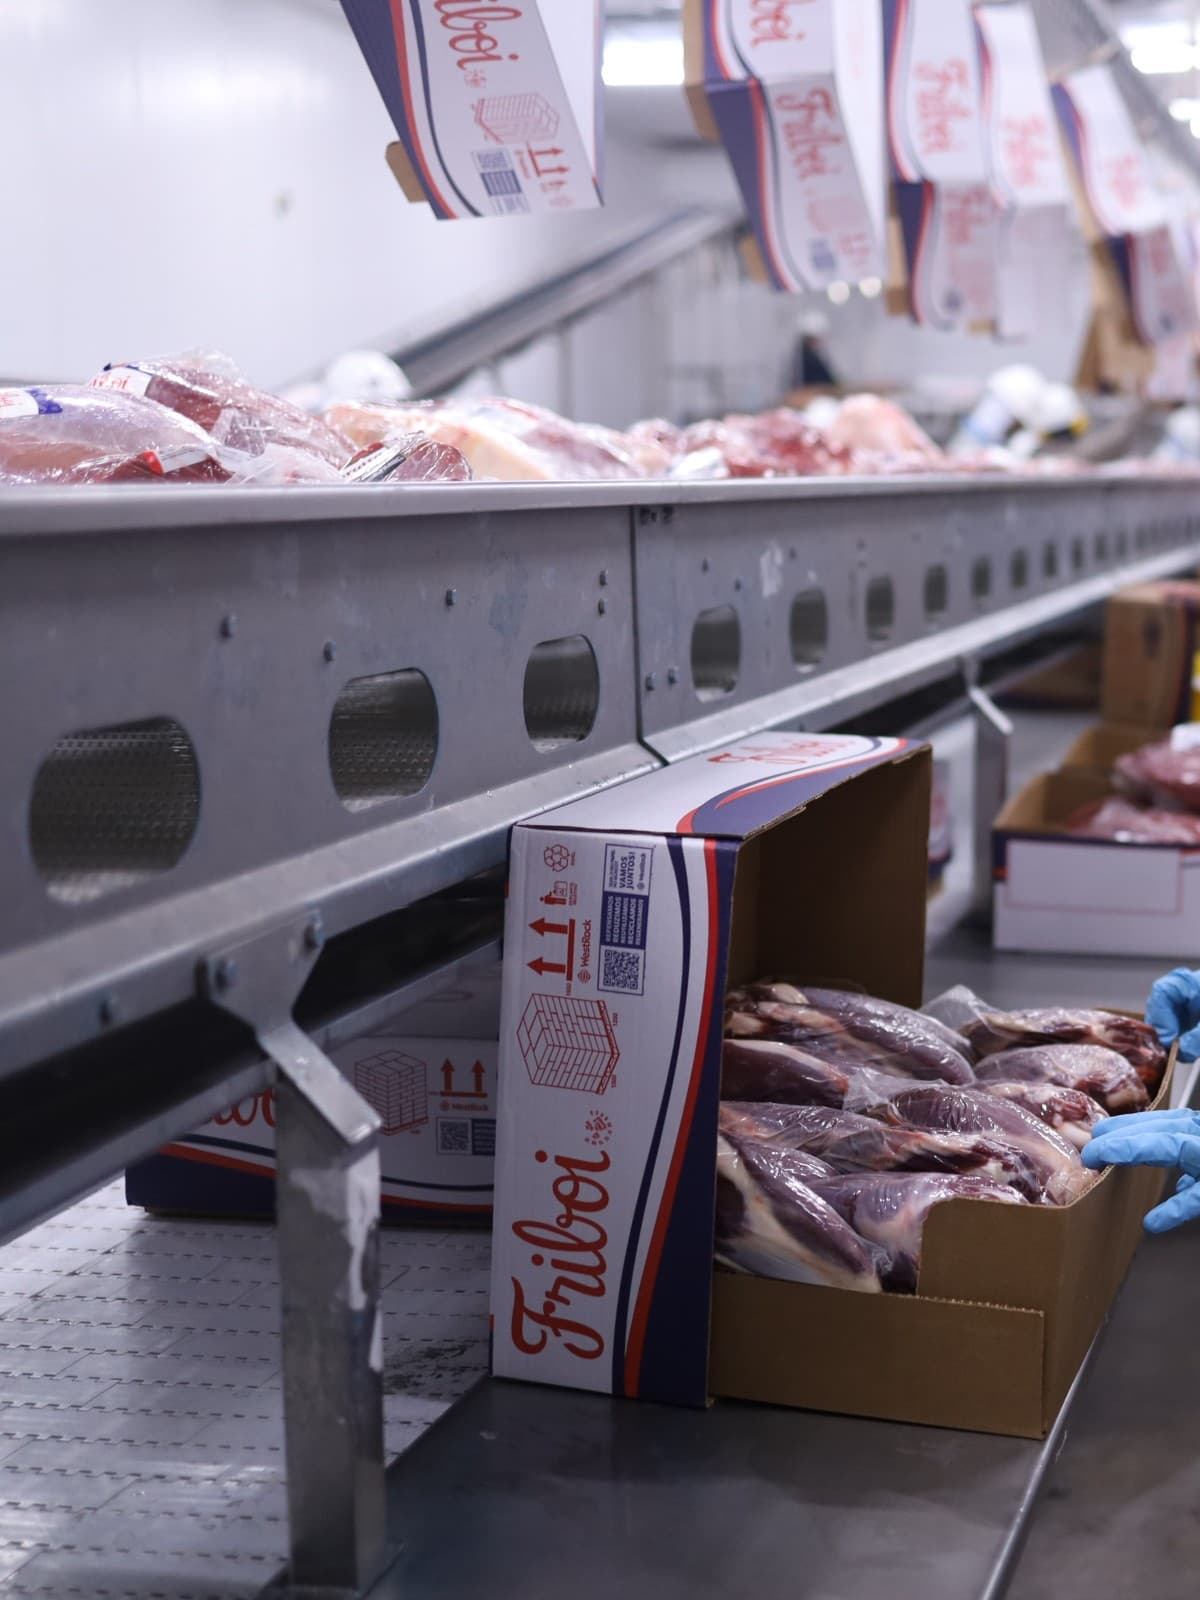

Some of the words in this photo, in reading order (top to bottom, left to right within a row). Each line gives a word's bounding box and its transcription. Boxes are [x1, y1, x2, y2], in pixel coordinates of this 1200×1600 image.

[434, 0, 522, 70] iboi
[619, 856, 628, 888] VAMOS
[626, 851, 636, 890] JUNTOS!
[580, 919, 592, 968] WestRock
[612, 896, 621, 944] REDUZIMOS
[627, 898, 636, 945] RECICLAMOS
[511, 1149, 611, 1360] Friboi
